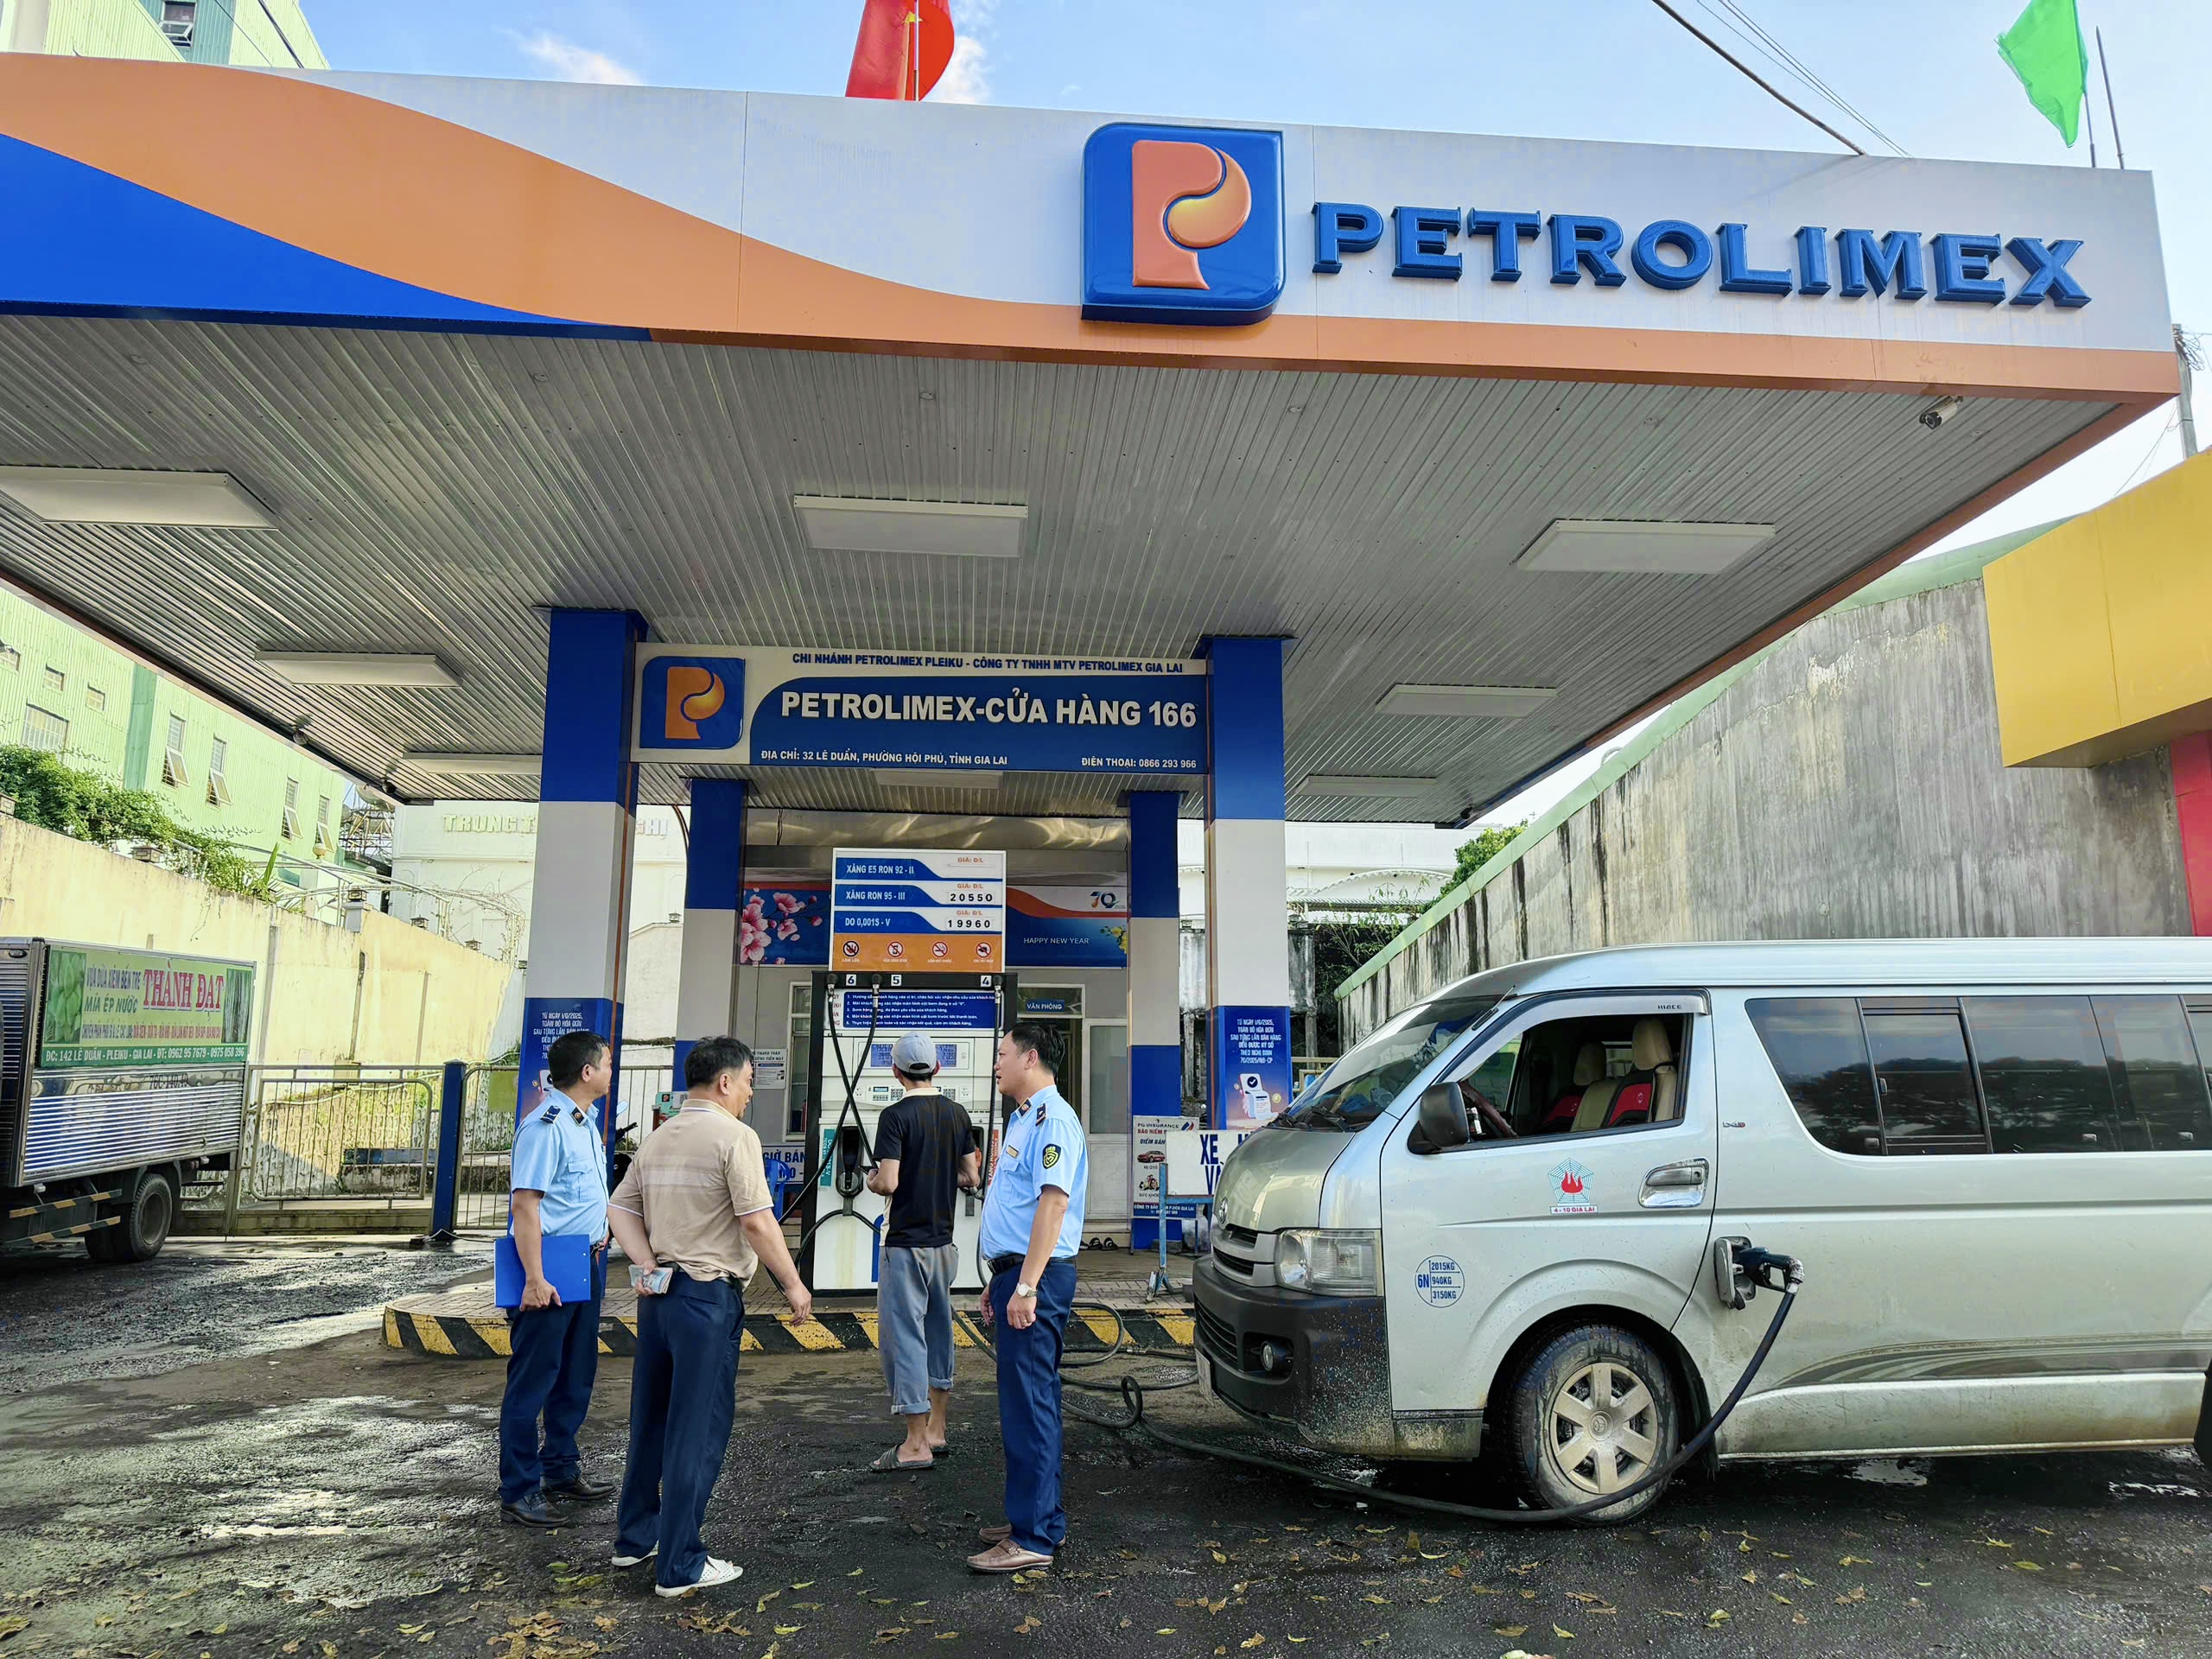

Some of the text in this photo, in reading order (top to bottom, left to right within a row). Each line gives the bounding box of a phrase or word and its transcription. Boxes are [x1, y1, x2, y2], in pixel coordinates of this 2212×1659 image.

[1312, 201, 2091, 308] PETROLIMEX
[792, 652, 1182, 673] CHI NHÁNH PETROLIMEX PLEIKU CÔNG TY TNHH MTV PETROLIMEX GIA LAI
[781, 688, 1197, 728] PETROLIMEX-CỬA HÀNG 166
[761, 750, 778, 761] ĐỊA
[780, 748, 800, 761] CHỈ:
[802, 750, 814, 760] 32
[816, 749, 828, 761] LÊ
[862, 749, 903, 763] PHƯỜNG
[905, 752, 922, 764] HỘI
[924, 752, 947, 765] PHÚ,
[949, 751, 972, 765] TỈNH
[974, 755, 991, 765] GIA
[993, 755, 1007, 765] LAI
[1106, 758, 1137, 768] THOẠI:
[1138, 759, 1160, 768] 0866
[1162, 760, 1178, 768] 293
[1181, 760, 1196, 768] 966
[847, 864, 866, 874] XĂNG
[878, 865, 893, 874] RON
[895, 866, 904, 874] 92
[846, 890, 866, 900] XĂNG
[867, 892, 883, 900] RON
[884, 892, 893, 900] 95
[950, 893, 993, 902] 20550
[845, 918, 890, 928] DO 0,001S V
[947, 920, 991, 928] 19960
[847, 976, 855, 984] 6
[893, 976, 899, 985] 5
[982, 977, 989, 985] 4
[143, 961, 225, 1019] THÀNH ĐẠT
[84, 993, 138, 1013] MÍA ÉP NƯỚC
[1041, 1002, 1063, 1010] PHÒNG
[46, 1050, 57, 1062] ĐC:
[59, 1050, 72, 1061] 142
[106, 1049, 128, 1060] PLEIKU
[133, 1049, 142, 1059] GIA
[143, 1049, 153, 1059] LAI
[157, 1048, 167, 1058] ĐT:
[168, 1048, 183, 1058] 0962
[184, 1048, 191, 1058] 95
[193, 1048, 207, 1058] 7679
[210, 1047, 223, 1058] 0975
[225, 1047, 234, 1057] 058
[235, 1047, 245, 1057] 396
[1200, 1134, 1219, 1164] XE
[1431, 1262, 1455, 1270] 2015KG
[1417, 1274, 1429, 1288] 6N
[1432, 1276, 1452, 1285] 940KG
[1433, 1291, 1456, 1299] 3150KG
